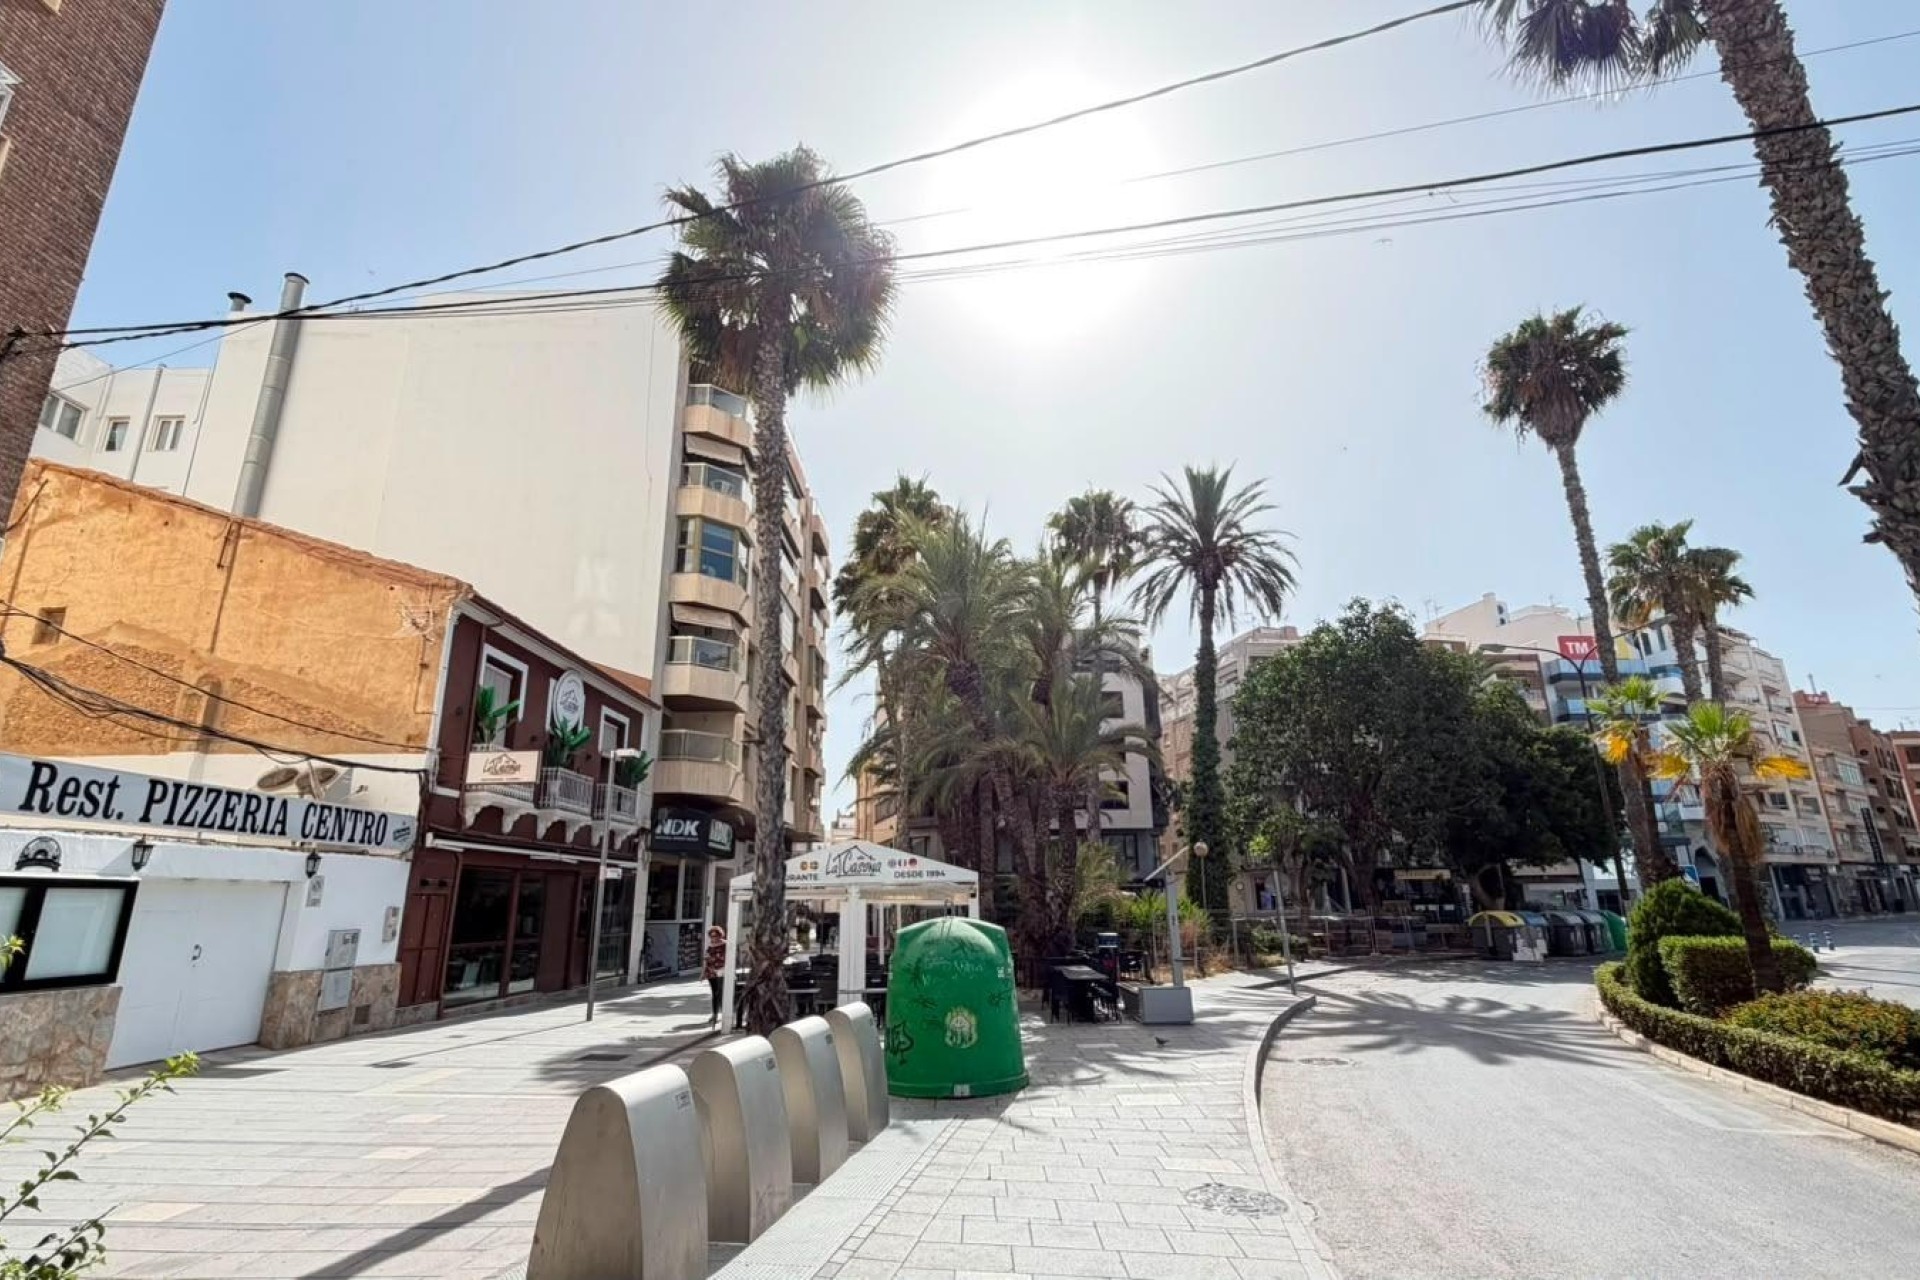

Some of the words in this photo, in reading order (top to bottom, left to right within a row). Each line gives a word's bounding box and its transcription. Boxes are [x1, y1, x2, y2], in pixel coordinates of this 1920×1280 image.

[1565, 642, 1589, 654] TM
[18, 761, 123, 819] Rest.
[139, 778, 288, 836] PIZZERIA
[301, 802, 388, 846] CENTRO
[894, 870, 924, 879] DESDE
